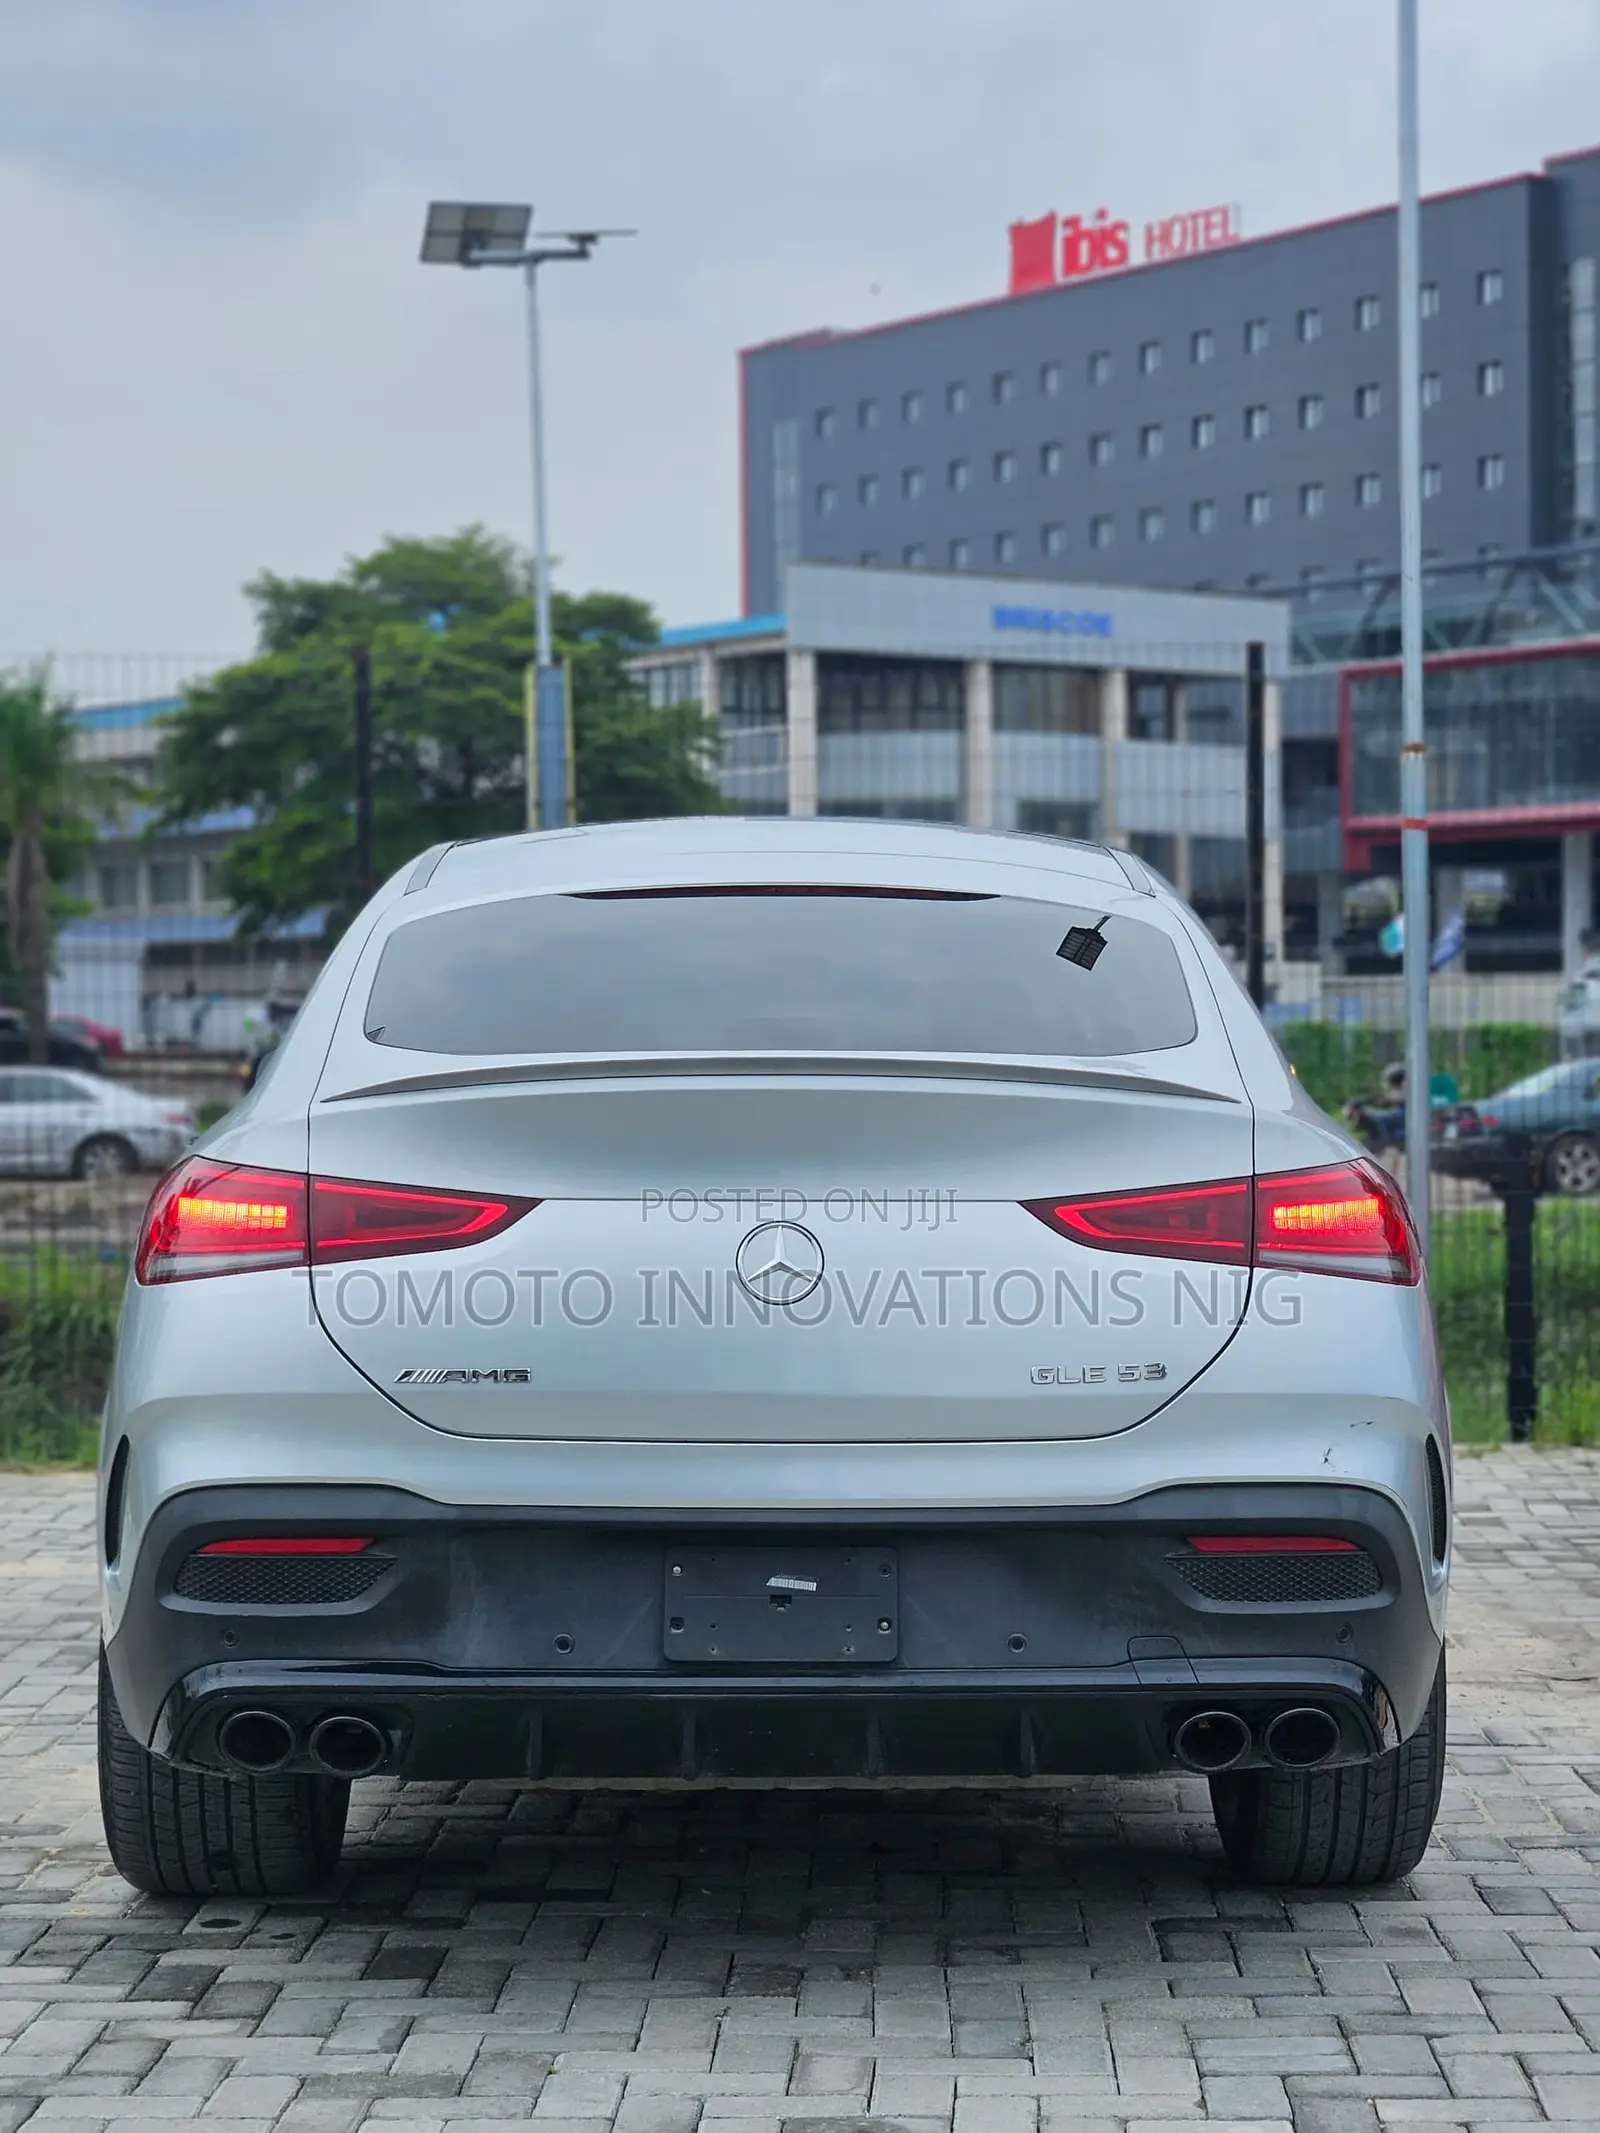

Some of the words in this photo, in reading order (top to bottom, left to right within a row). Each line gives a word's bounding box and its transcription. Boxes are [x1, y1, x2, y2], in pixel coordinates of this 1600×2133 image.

[1062, 206, 1129, 277] ibis
[1144, 203, 1240, 262] HOTEL
[1030, 1365, 1107, 1384] GLE
[1117, 1362, 1167, 1382] 53
